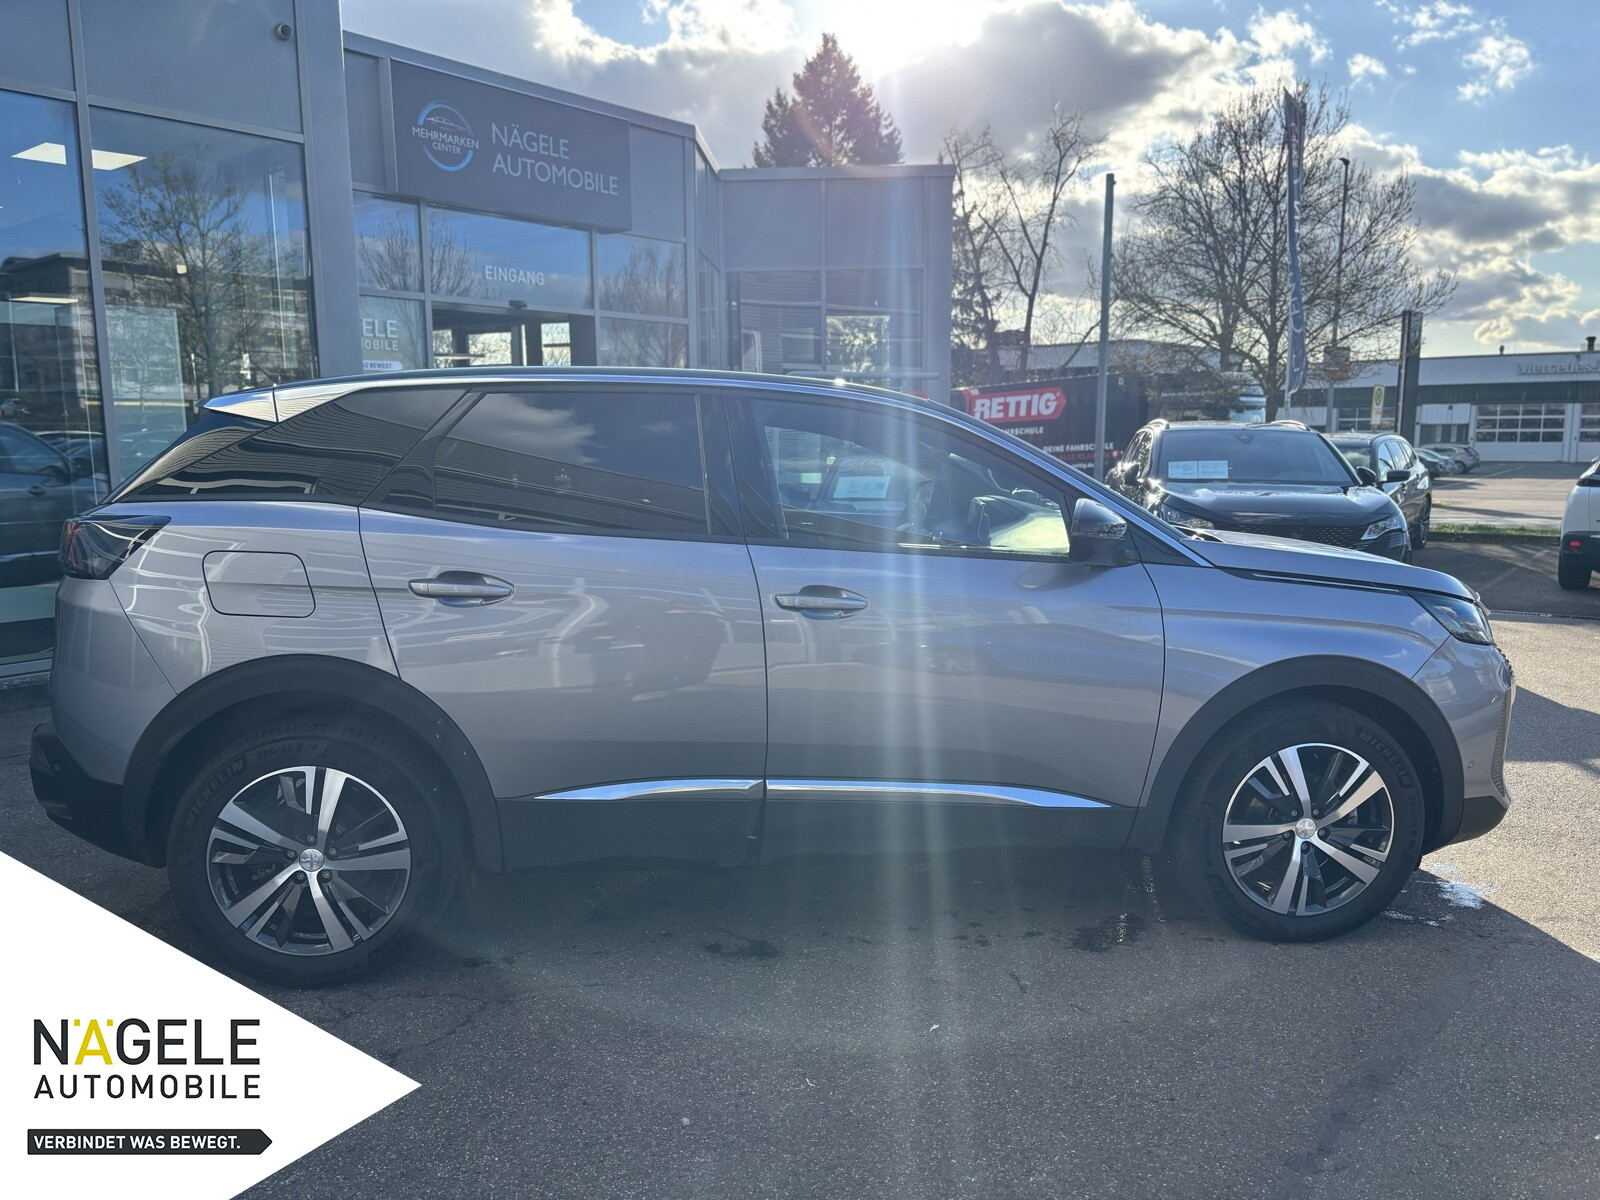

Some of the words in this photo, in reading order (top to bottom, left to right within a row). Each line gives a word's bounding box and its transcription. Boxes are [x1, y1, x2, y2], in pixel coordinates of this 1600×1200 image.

[412, 126, 479, 149] MEHRMARKEN
[432, 141, 461, 155] CENTER
[492, 122, 570, 159] NÄGELE
[492, 152, 618, 196] AUTOMOBILE
[485, 265, 545, 286] EINGANG
[362, 318, 398, 338] ELE
[369, 362, 394, 370] BEWEGT.
[973, 392, 1058, 420] RETTIG
[1043, 445, 1064, 453] DEINE
[1065, 442, 1114, 452] FAHRSCLE
[1358, 731, 1412, 787] MICHELIN
[184, 759, 245, 829] MICHELIN
